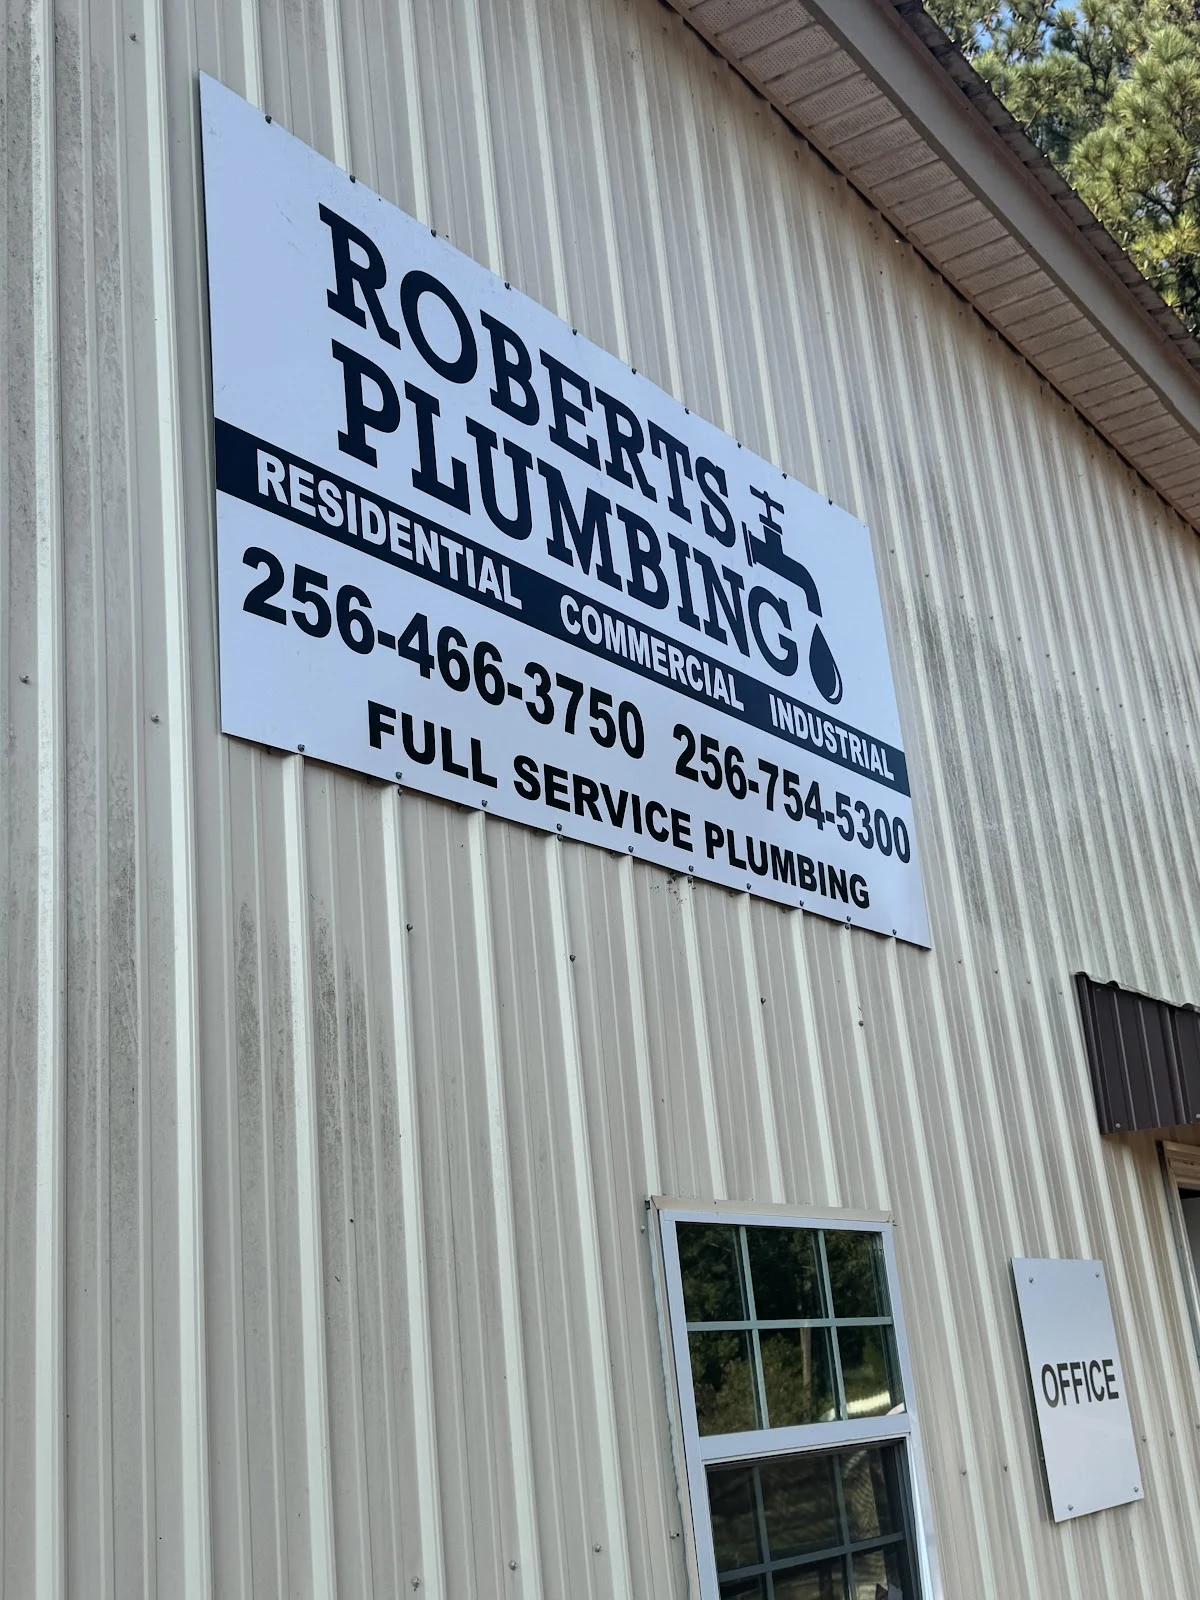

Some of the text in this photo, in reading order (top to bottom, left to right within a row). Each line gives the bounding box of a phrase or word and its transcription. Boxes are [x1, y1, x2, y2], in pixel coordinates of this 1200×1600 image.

[318, 202, 736, 548] ROBERTS
[331, 338, 799, 678] PLUMBING
[242, 546, 911, 864] 256-466-3750 256-754-5300
[256, 451, 894, 781] RESIDENTIAL COMMERCIAL INDUSTRIAL
[367, 699, 870, 909] FULL SERVICE PLUMBING
[1042, 1359, 1119, 1408] OFFICE
